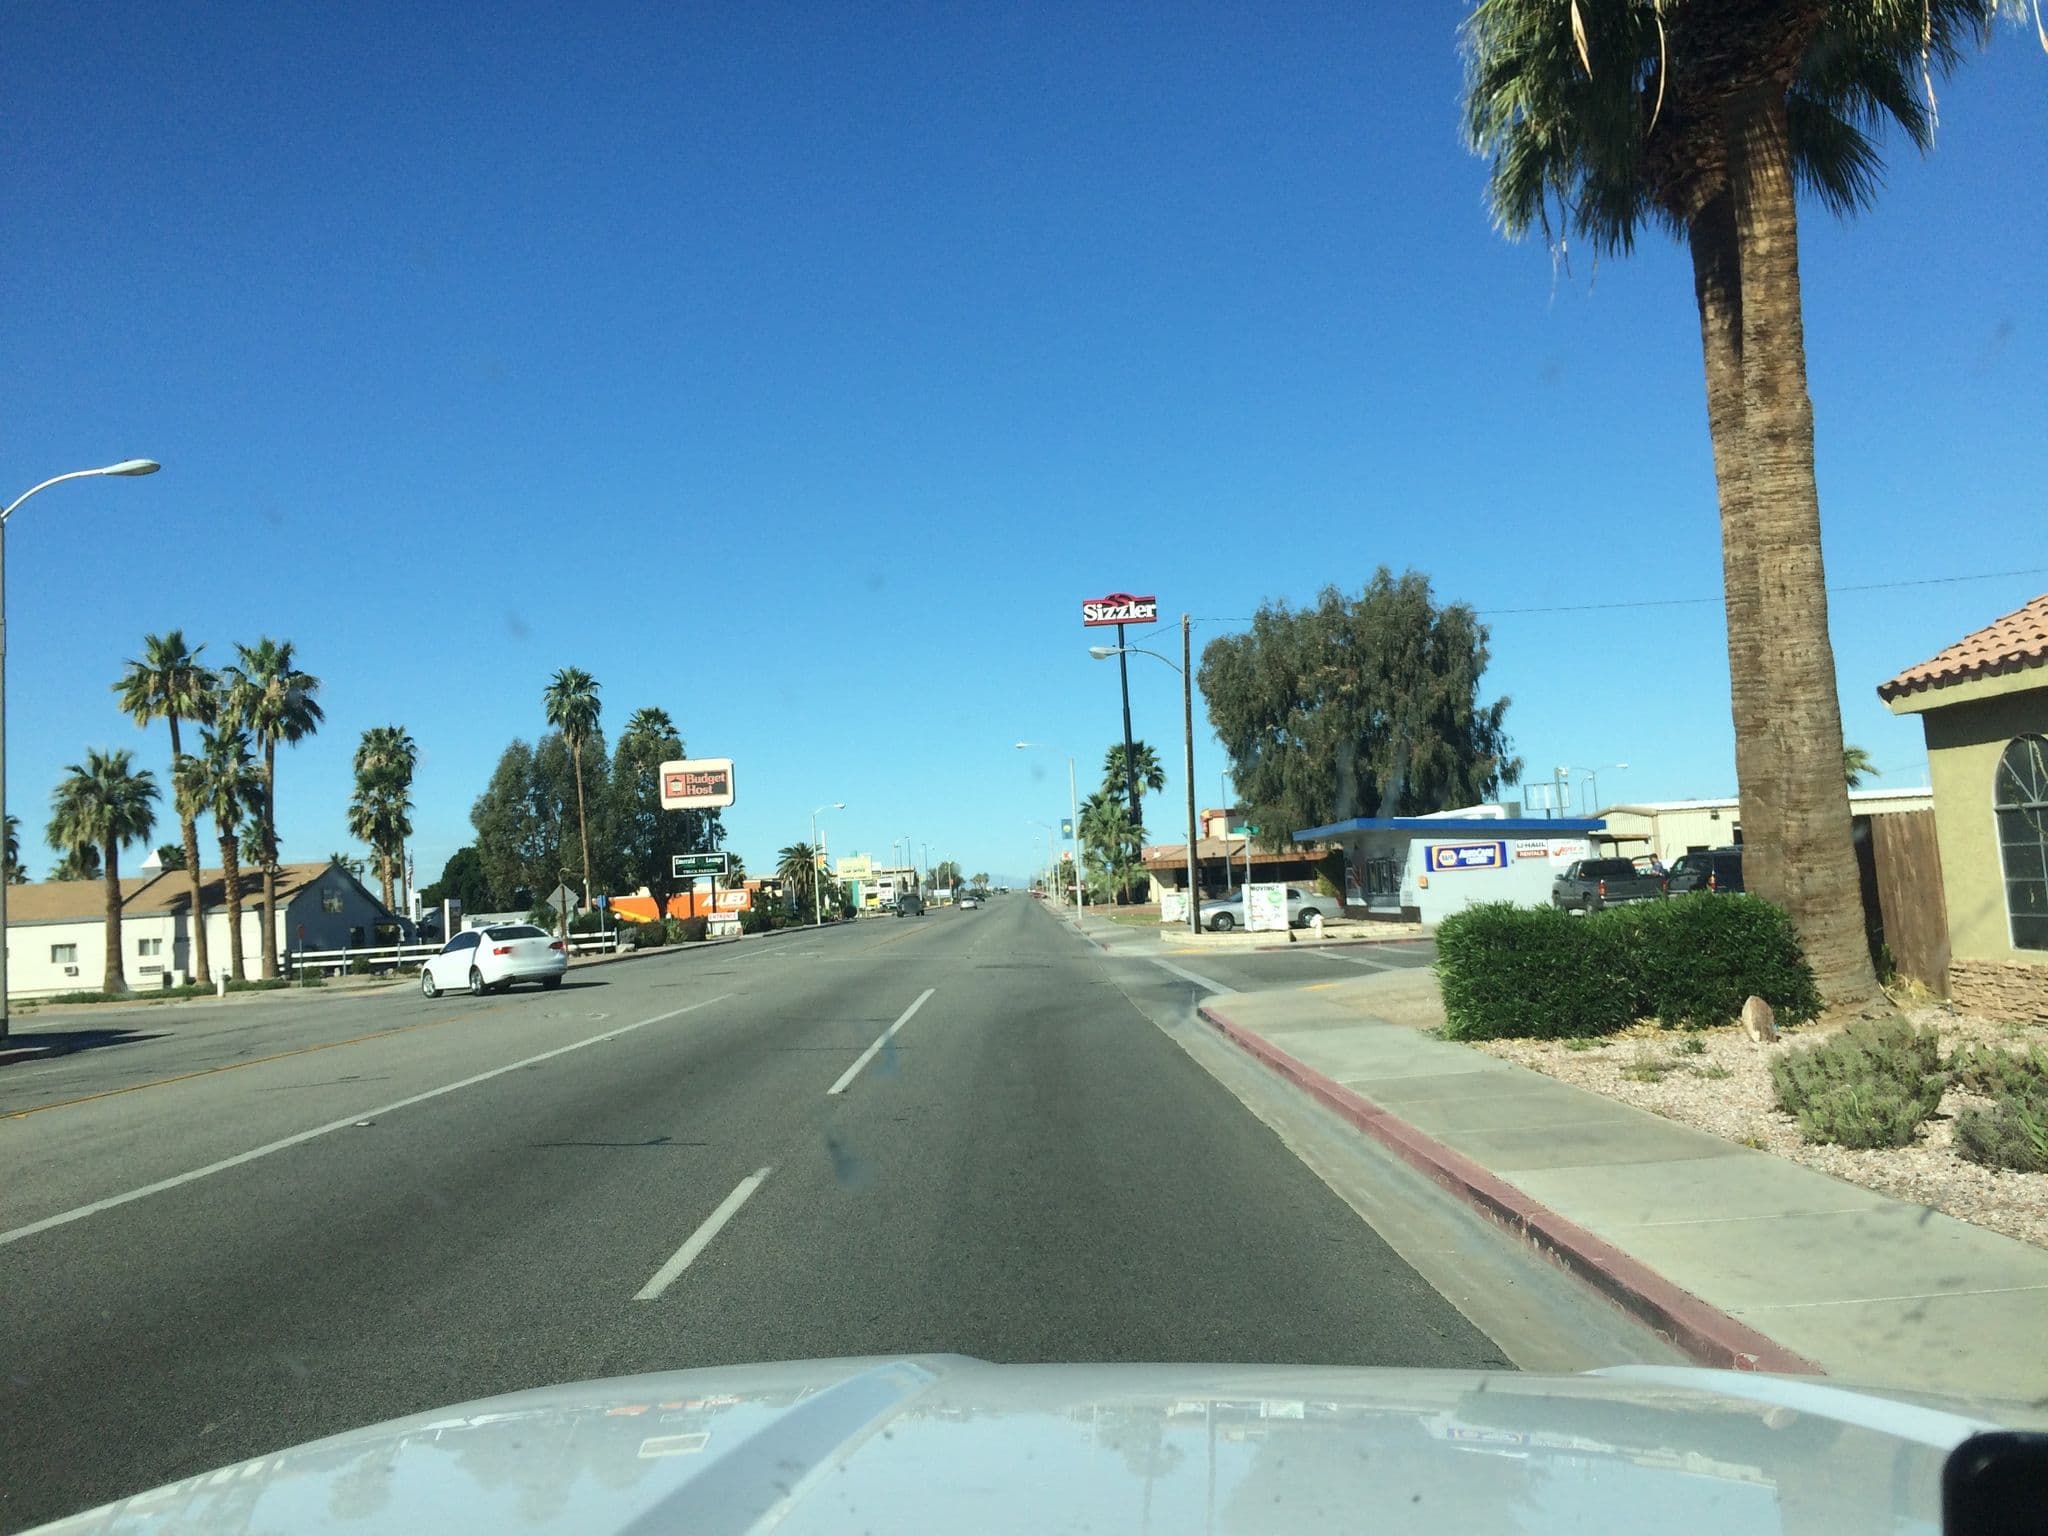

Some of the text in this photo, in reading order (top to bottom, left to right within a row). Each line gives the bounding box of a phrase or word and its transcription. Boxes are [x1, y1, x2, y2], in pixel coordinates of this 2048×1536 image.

[1084, 600, 1156, 621] Sizzler
[686, 772, 726, 785] Budget
[686, 783, 713, 795] Host
[701, 892, 747, 907] ALLIED
